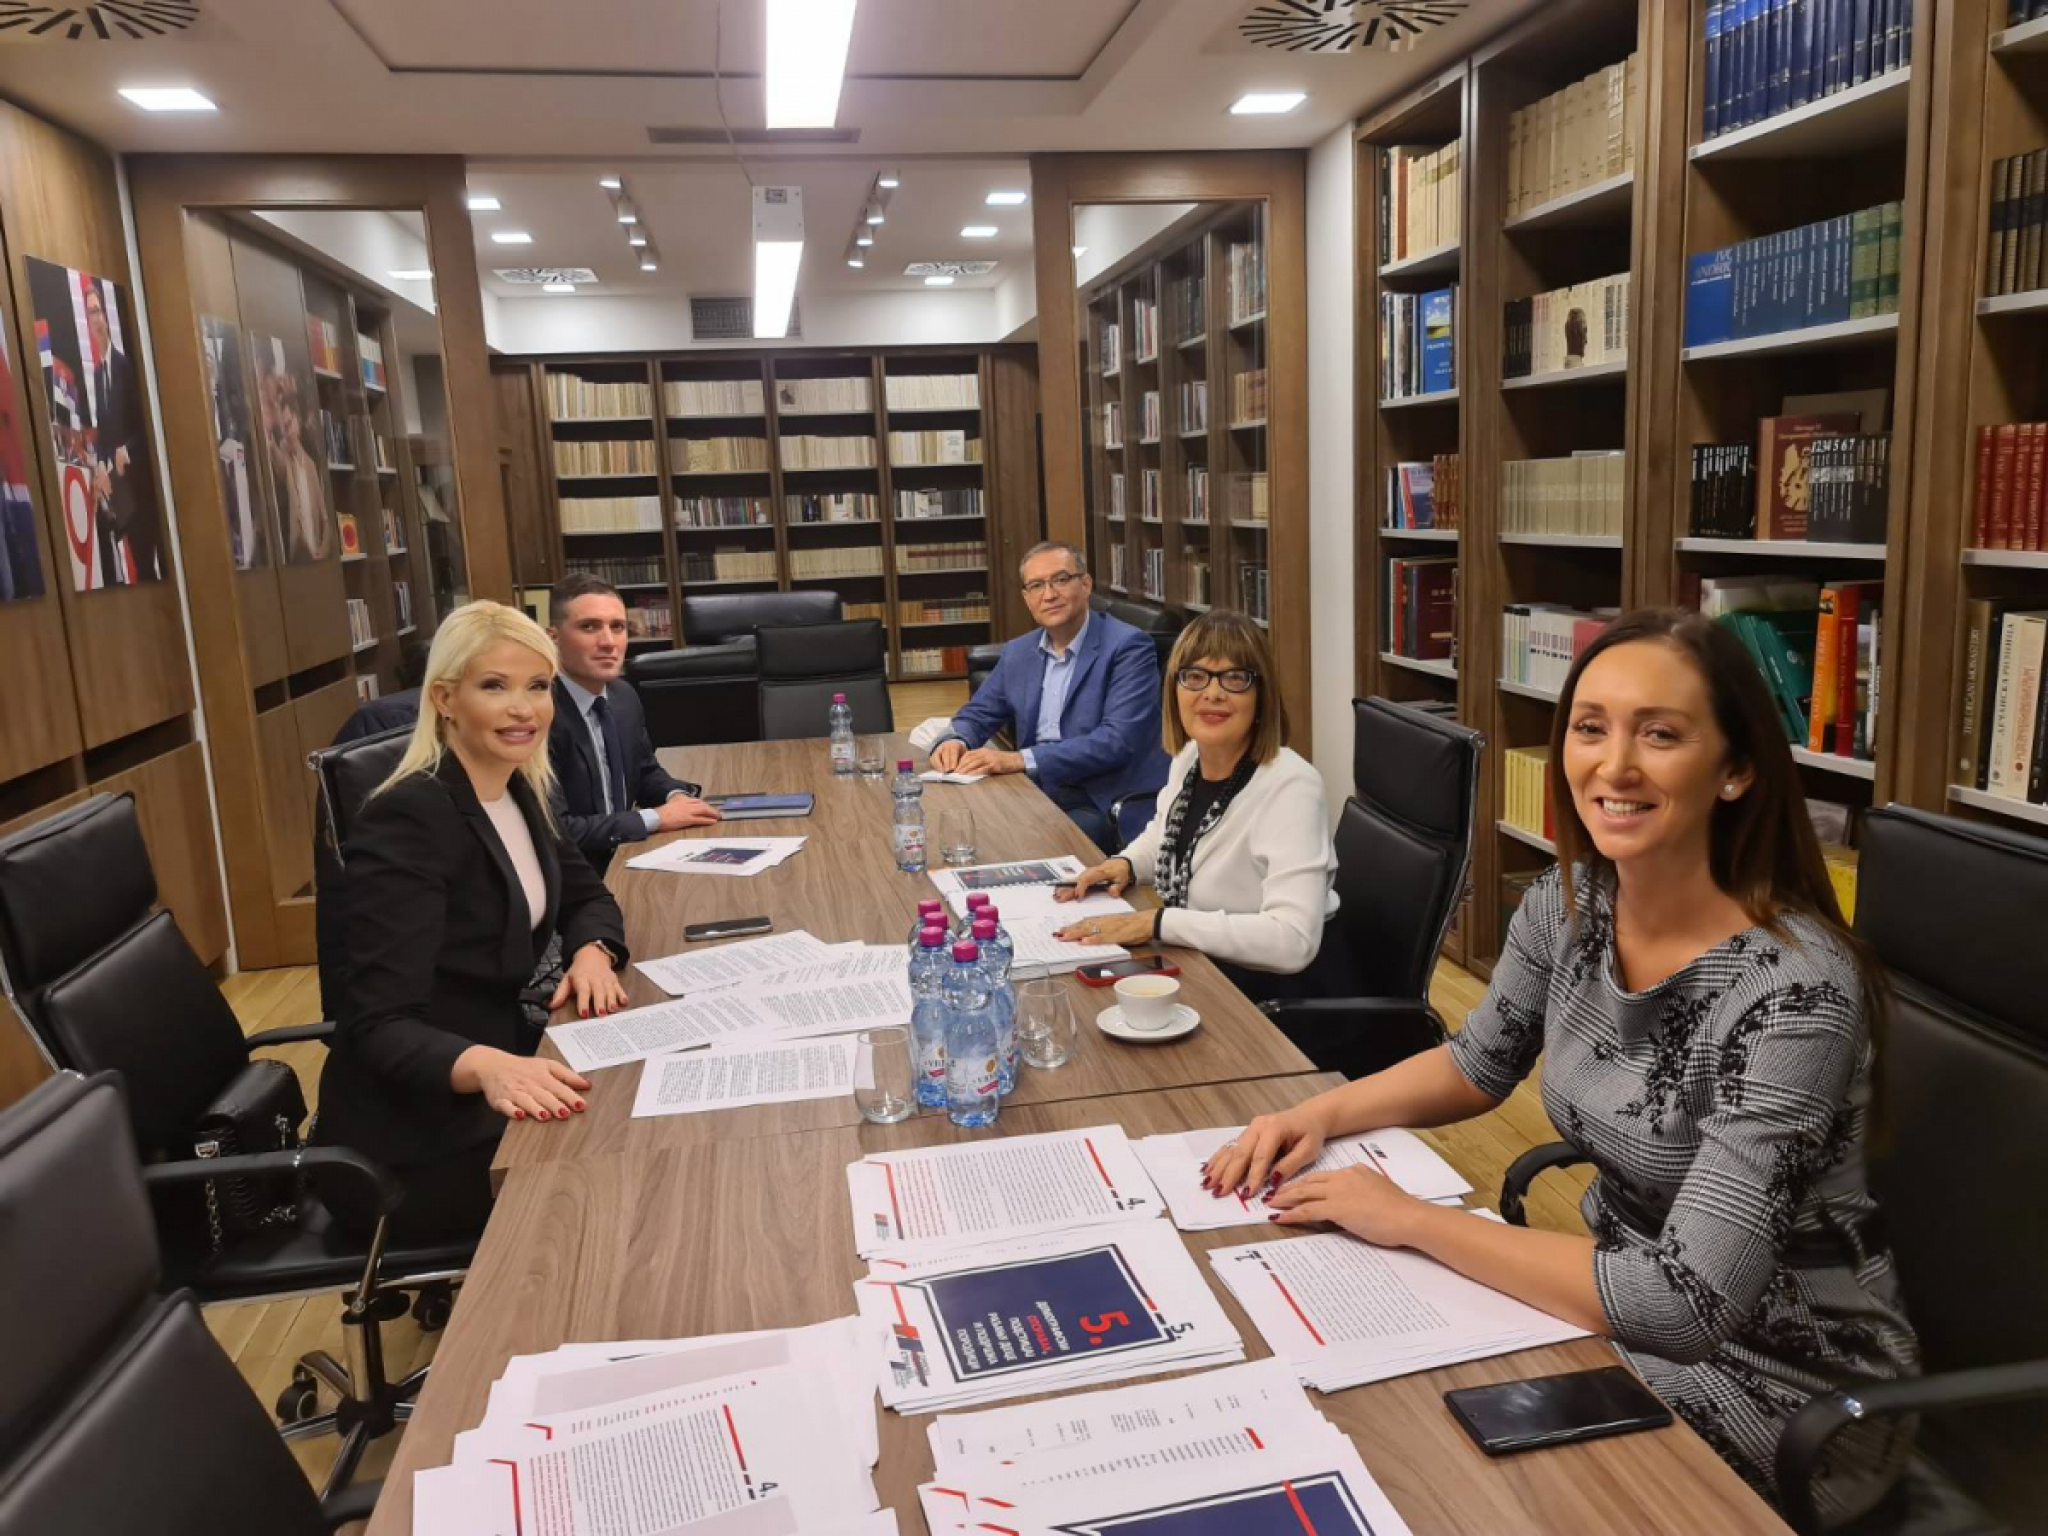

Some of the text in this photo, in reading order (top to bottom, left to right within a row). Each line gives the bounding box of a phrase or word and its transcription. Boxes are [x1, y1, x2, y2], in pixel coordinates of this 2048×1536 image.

[1080, 1310, 1130, 1345] 5.
[1171, 1322, 1194, 1340] 5.
[759, 1482, 779, 1498] 4.
